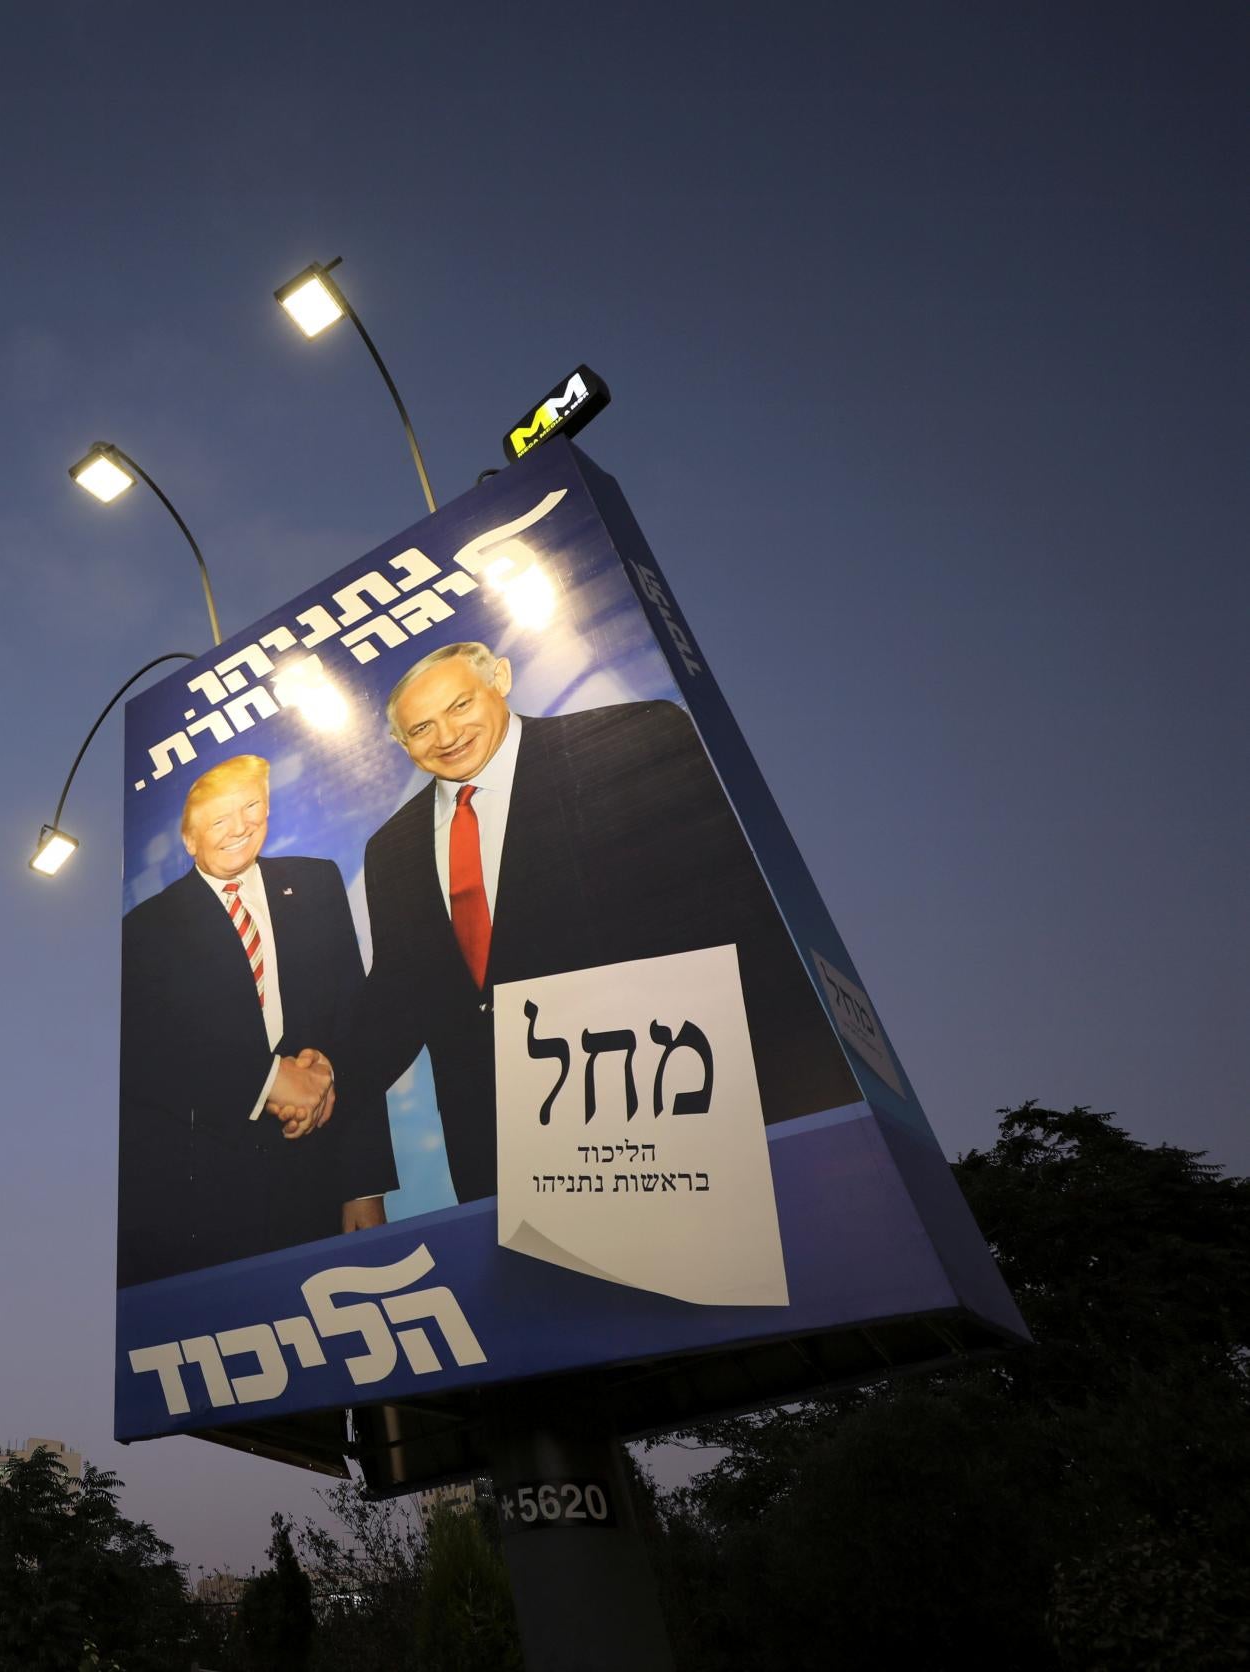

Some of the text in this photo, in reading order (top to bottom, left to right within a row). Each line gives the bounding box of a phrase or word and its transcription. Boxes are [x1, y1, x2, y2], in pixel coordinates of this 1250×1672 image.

[517, 438, 539, 458] MEGA
[539, 416, 563, 438] MEDIA
[339, 488, 568, 665] ליגה
[820, 961, 876, 1037] מחל
[523, 999, 715, 1127] מחל
[532, 1171, 710, 1193] בראשות נתניהו
[577, 1139, 656, 1163] הליכוד
[128, 1242, 488, 1416] הליכוד
